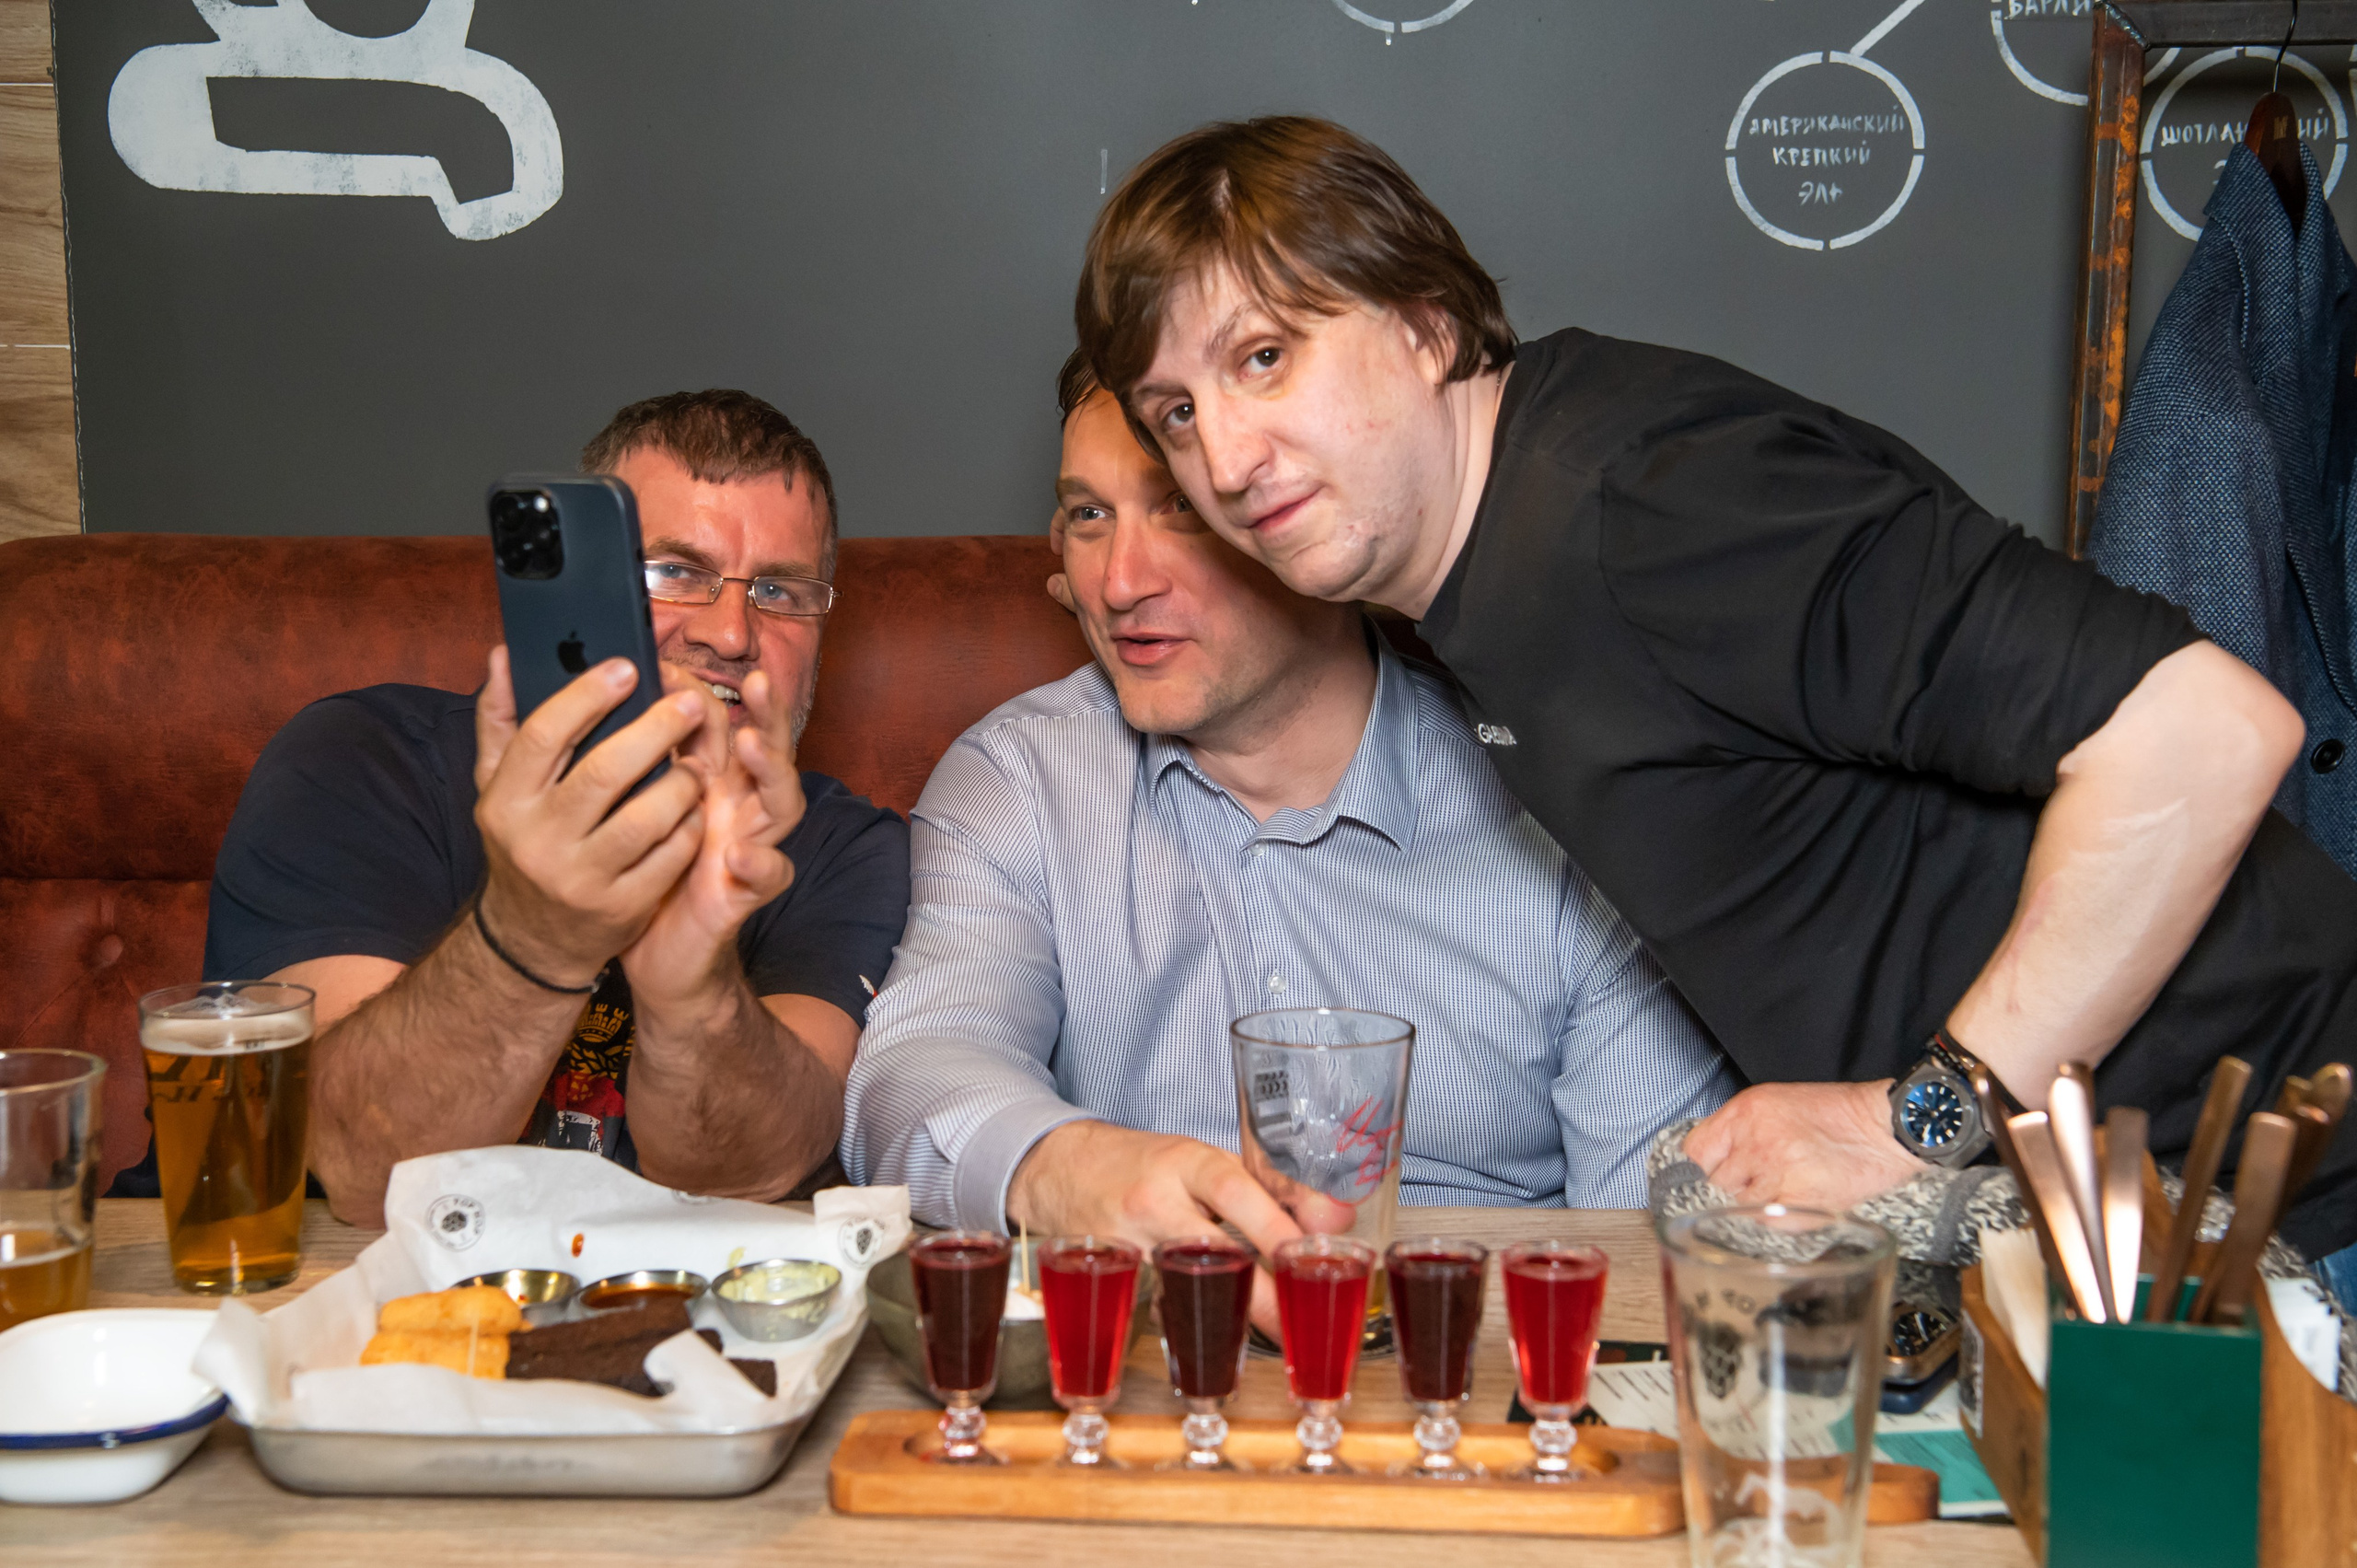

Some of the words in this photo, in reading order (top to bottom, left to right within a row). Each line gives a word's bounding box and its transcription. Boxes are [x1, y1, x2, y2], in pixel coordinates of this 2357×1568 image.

[1748, 104, 1905, 137] АМЕРИКАНСКИЙ
[2160, 108, 2329, 146] ШОТЛАНИЙ
[1772, 140, 1871, 168] КРЕПКИЙ
